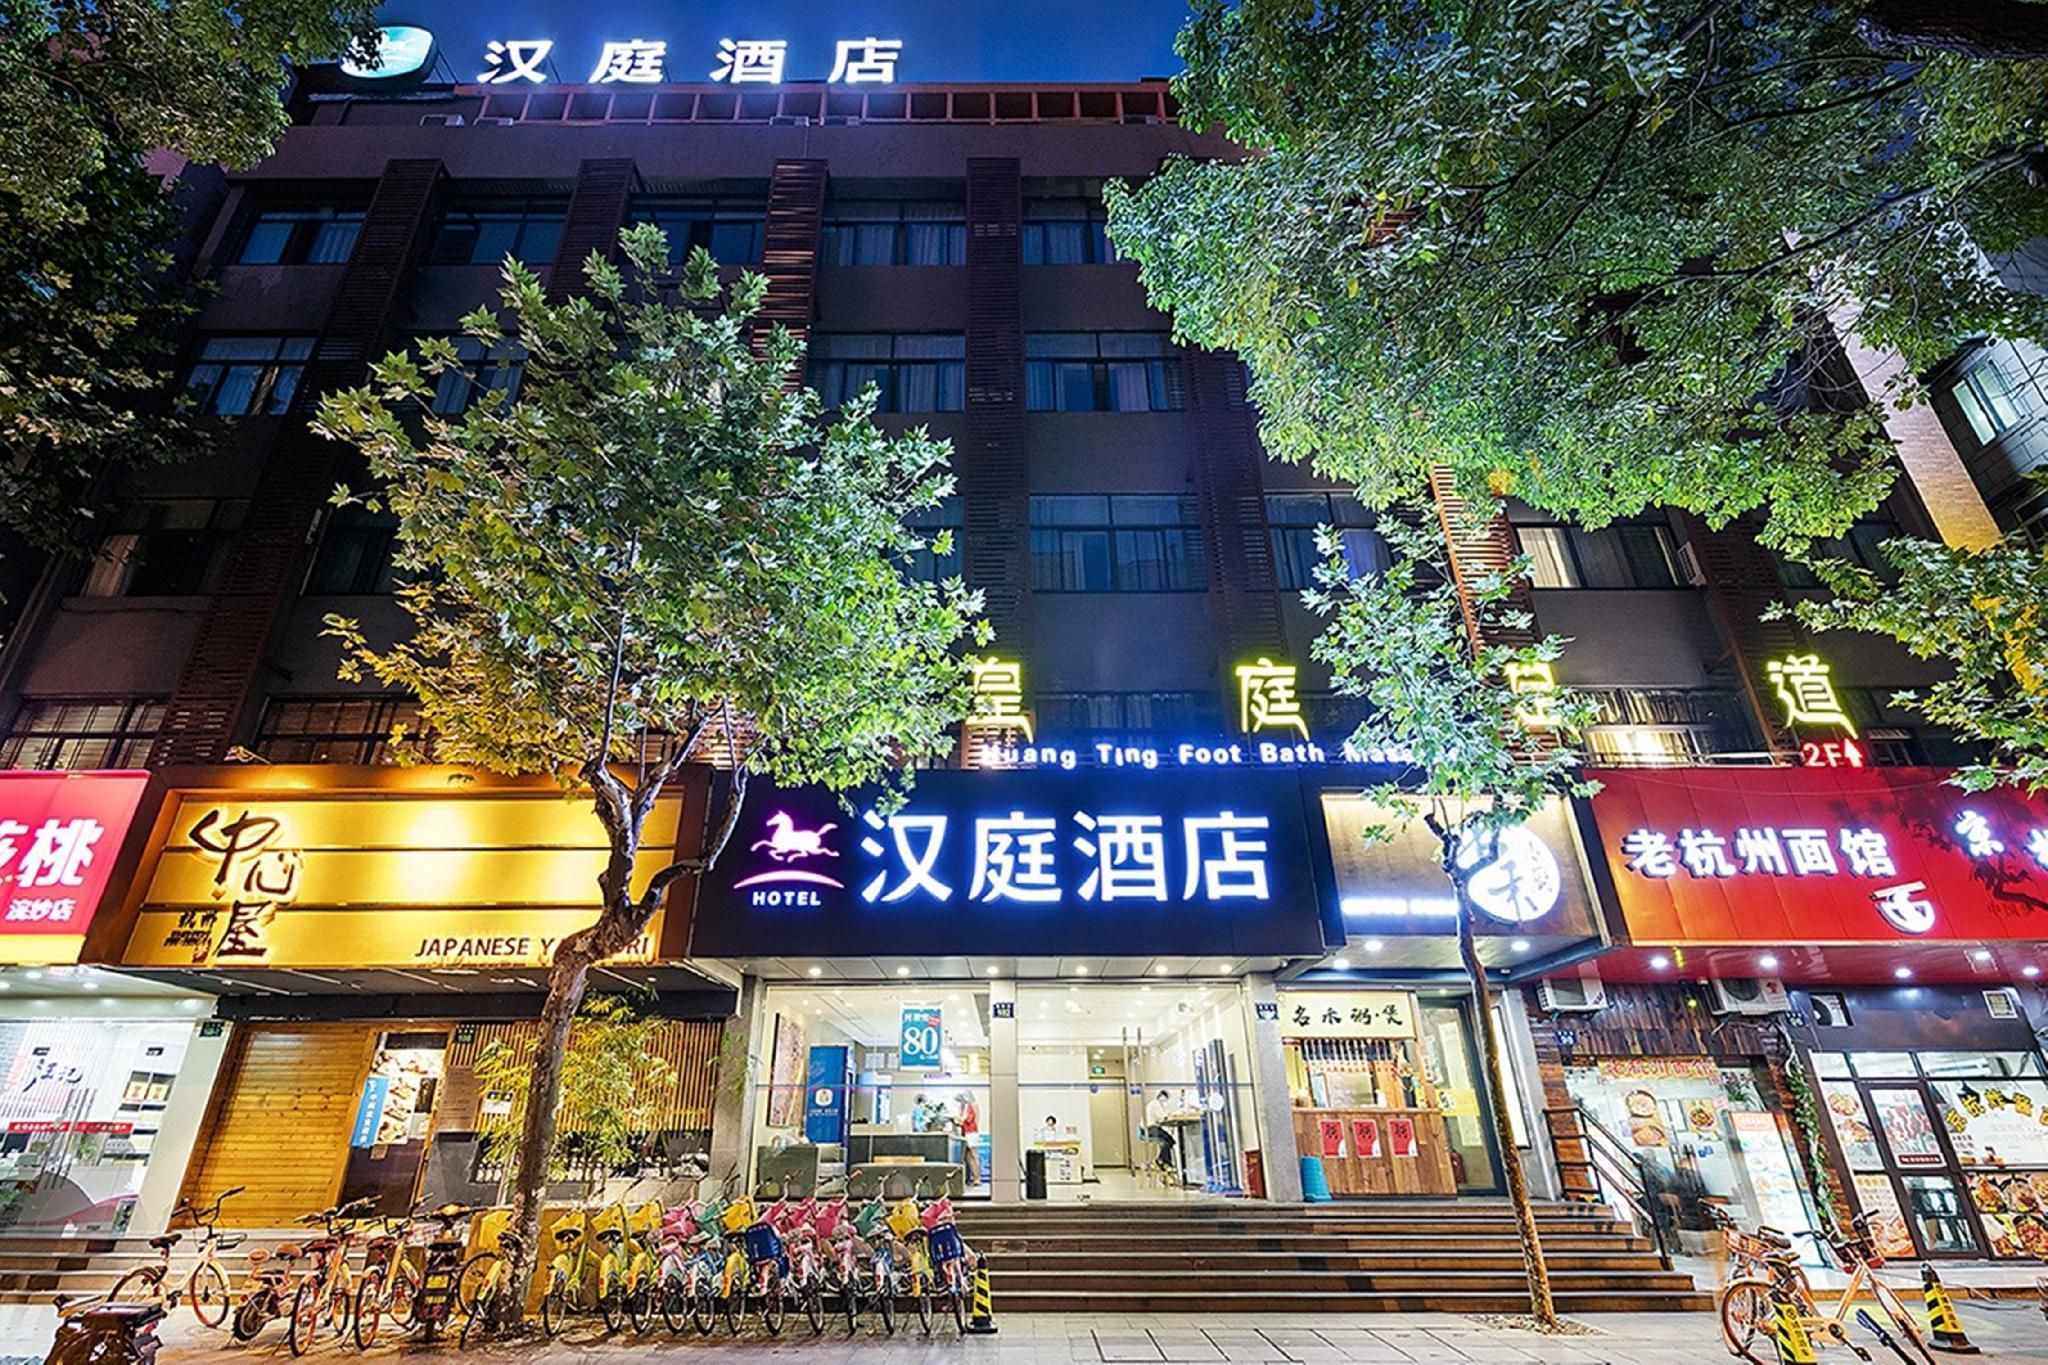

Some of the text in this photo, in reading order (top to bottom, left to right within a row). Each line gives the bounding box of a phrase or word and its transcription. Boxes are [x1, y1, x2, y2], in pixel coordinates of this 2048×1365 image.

[476, 37, 903, 84] 汉庭酒店
[982, 744, 1077, 769] Huang
[1096, 743, 1158, 769] Ting
[1179, 744, 1242, 764] Foot
[1261, 742, 1326, 764] Bath
[1802, 744, 1842, 767] 2F
[861, 810, 1270, 903] 汉庭酒店
[1622, 826, 1897, 879] 老杭州面馆
[190, 809, 298, 957] 中心屋
[753, 891, 821, 906] HOTEL
[415, 938, 530, 957] JAPANESE
[903, 1026, 938, 1056] 80
